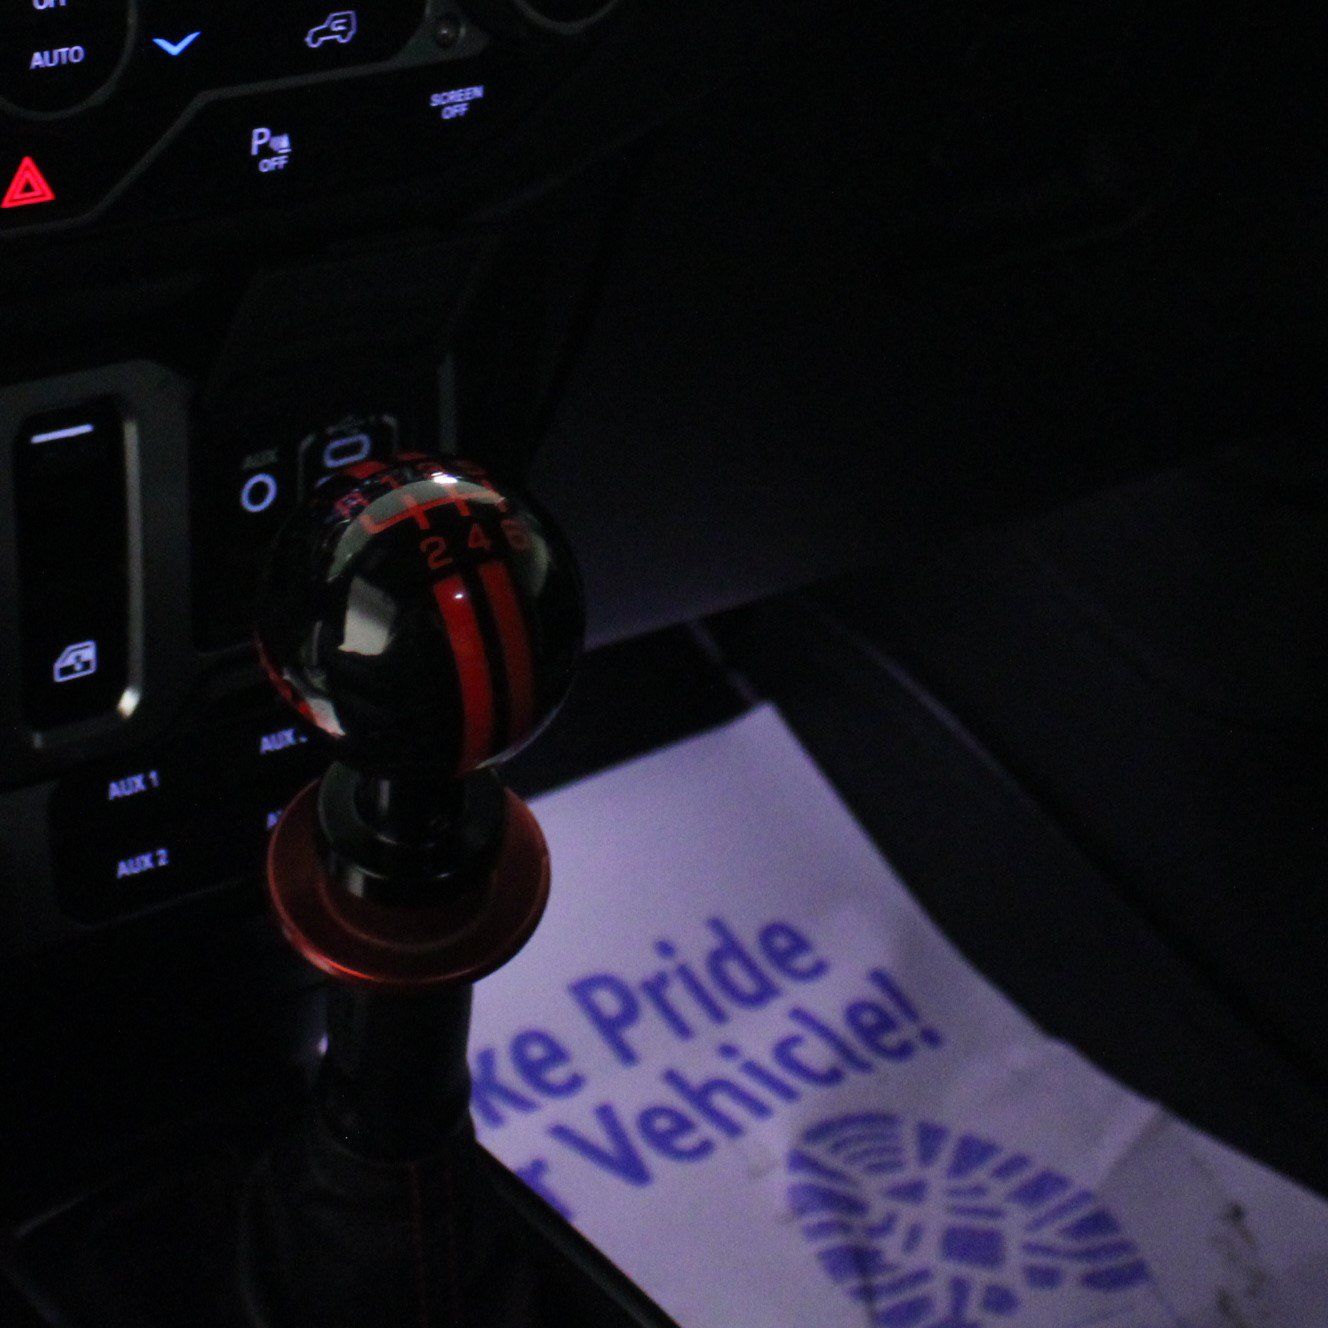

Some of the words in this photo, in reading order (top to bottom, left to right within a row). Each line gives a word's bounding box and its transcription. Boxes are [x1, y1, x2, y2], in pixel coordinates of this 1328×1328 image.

[28, 44, 87, 71] AUTO
[440, 102, 469, 121] OFF
[258, 154, 290, 174] OFF
[259, 727, 298, 755] AUX
[108, 772, 148, 801] AUX
[149, 769, 161, 790] 1
[116, 851, 155, 880] AUX
[156, 847, 171, 868] 2
[567, 917, 829, 1068] Pride
[546, 968, 944, 1187] Vehicle!
